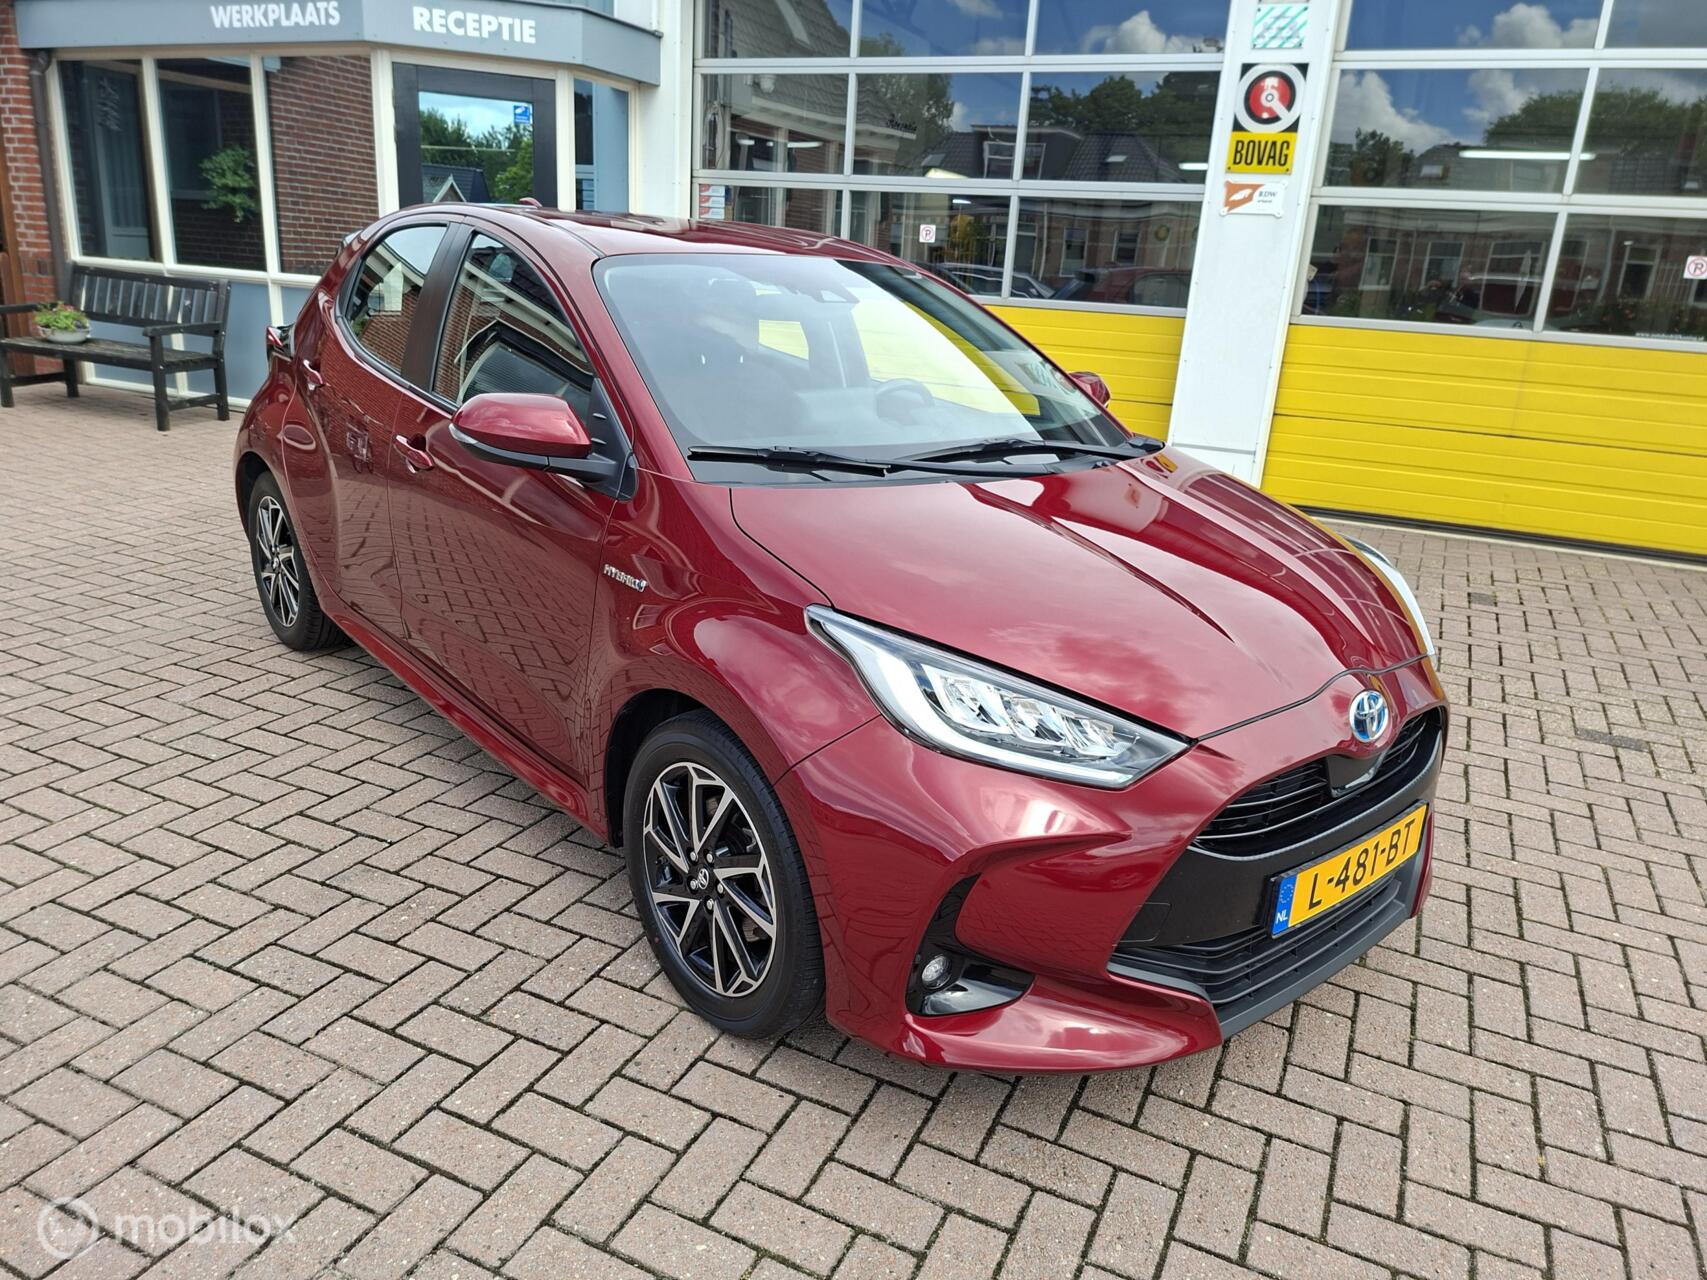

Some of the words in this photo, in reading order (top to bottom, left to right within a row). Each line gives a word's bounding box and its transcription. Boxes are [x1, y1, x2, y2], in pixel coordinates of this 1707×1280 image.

[210, 1, 341, 29] WERKPLAATS
[412, 6, 537, 44] RECEPTIE
[1232, 139, 1290, 167] BOVAG
[1308, 818, 1416, 911] L-481-BT
[1275, 909, 1289, 924] NL
